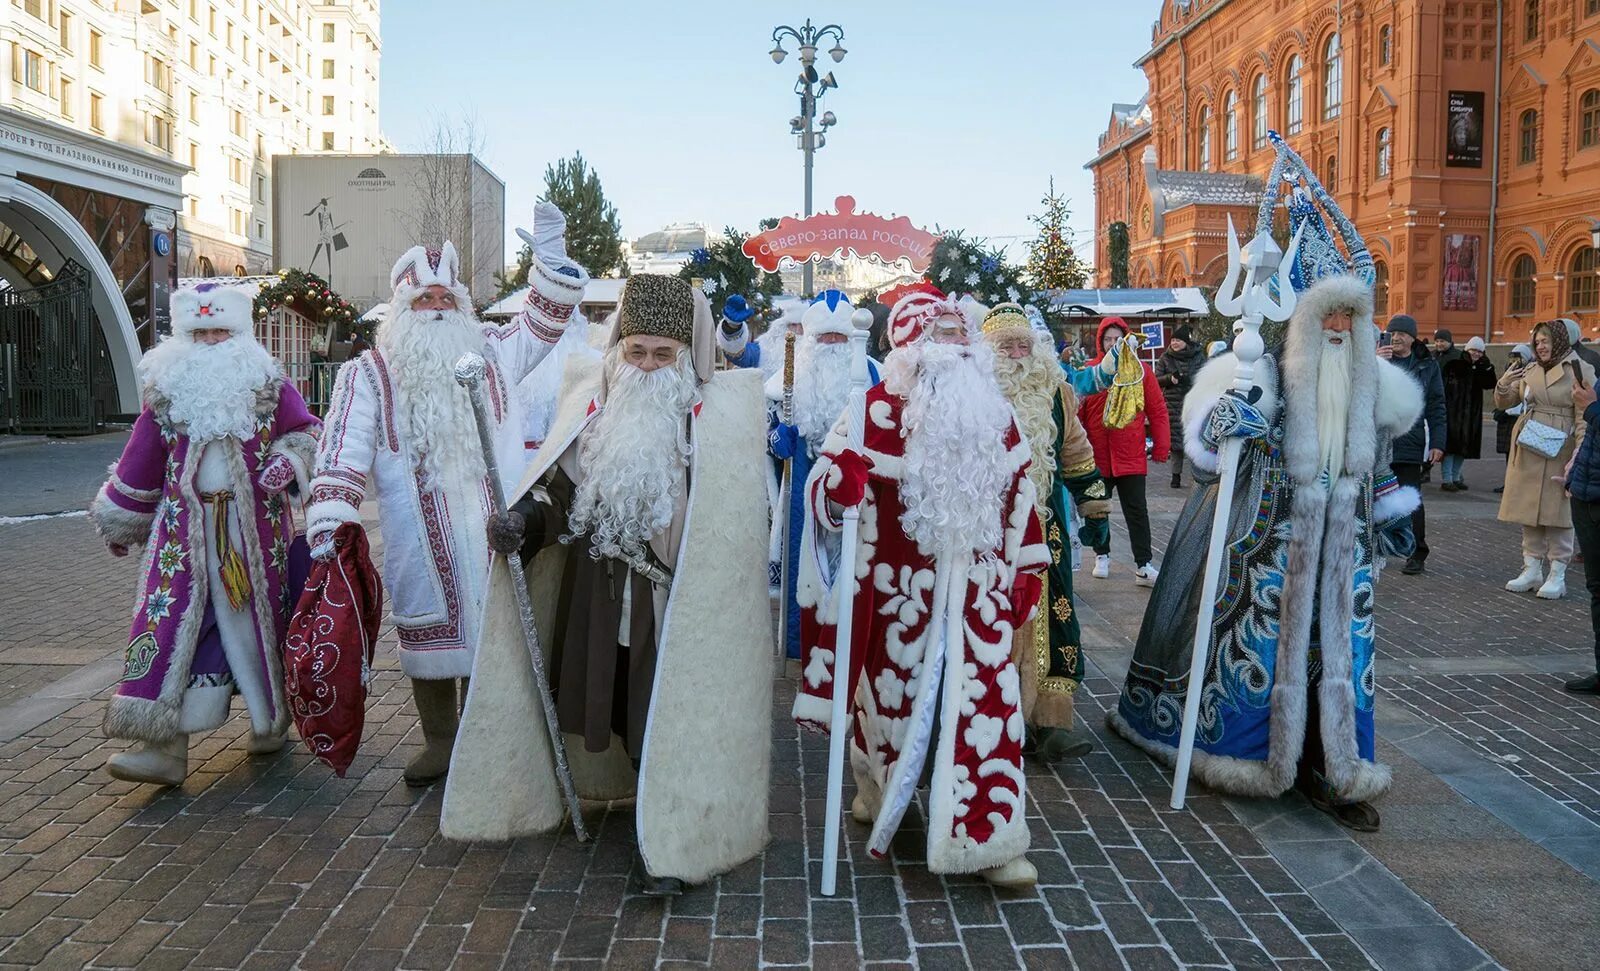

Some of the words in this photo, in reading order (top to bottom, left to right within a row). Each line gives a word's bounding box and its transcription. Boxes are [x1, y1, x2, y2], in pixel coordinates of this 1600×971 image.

[30, 138, 35, 147] В
[38, 141, 53, 153] ГОД
[56, 146, 116, 169] ПРАЗДНОВАНИЯ
[118, 164, 129, 173] 850
[154, 174, 175, 186] ГОРОДА
